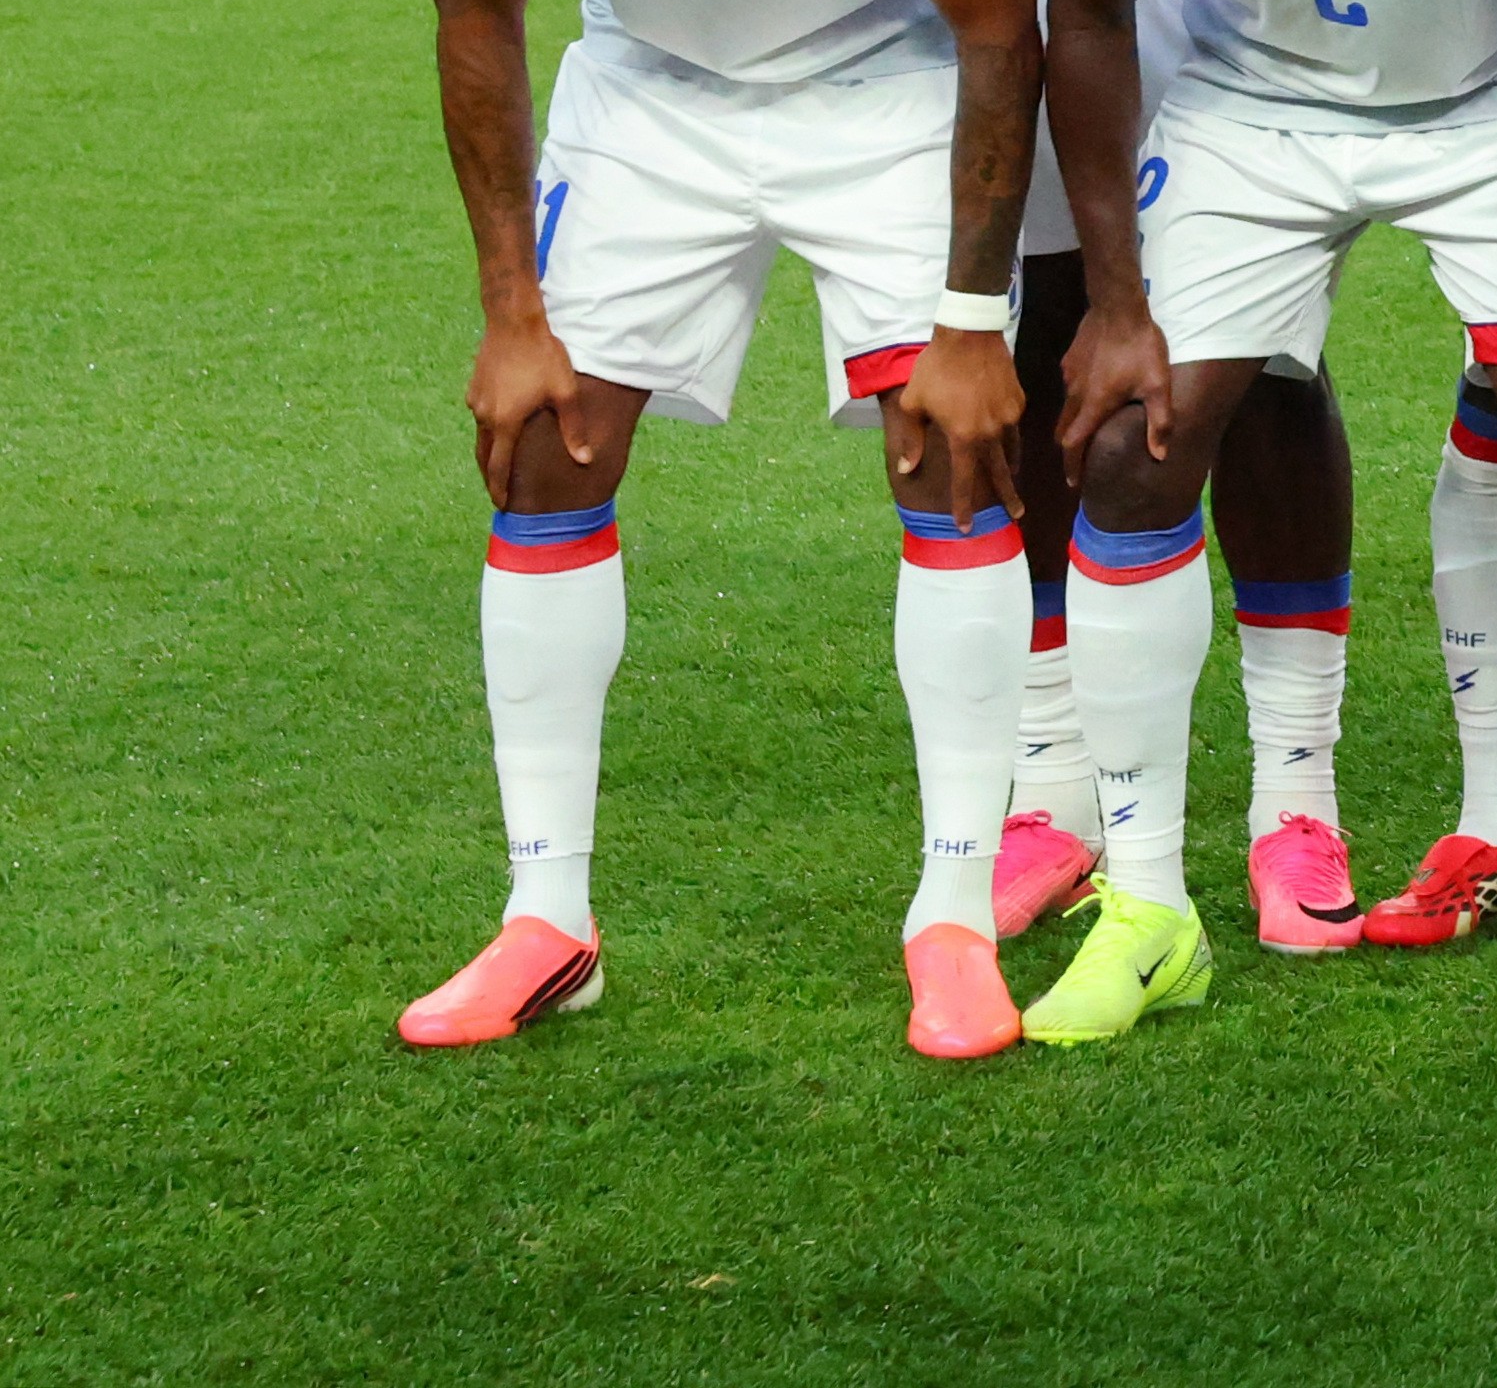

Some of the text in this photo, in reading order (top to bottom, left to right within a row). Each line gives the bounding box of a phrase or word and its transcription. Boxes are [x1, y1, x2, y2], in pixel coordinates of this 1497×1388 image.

[534, 180, 569, 283] 1
[1446, 628, 1486, 648] FHF
[1099, 767, 1142, 783] FHF
[511, 839, 549, 855] FHF
[933, 838, 977, 856] FHF
